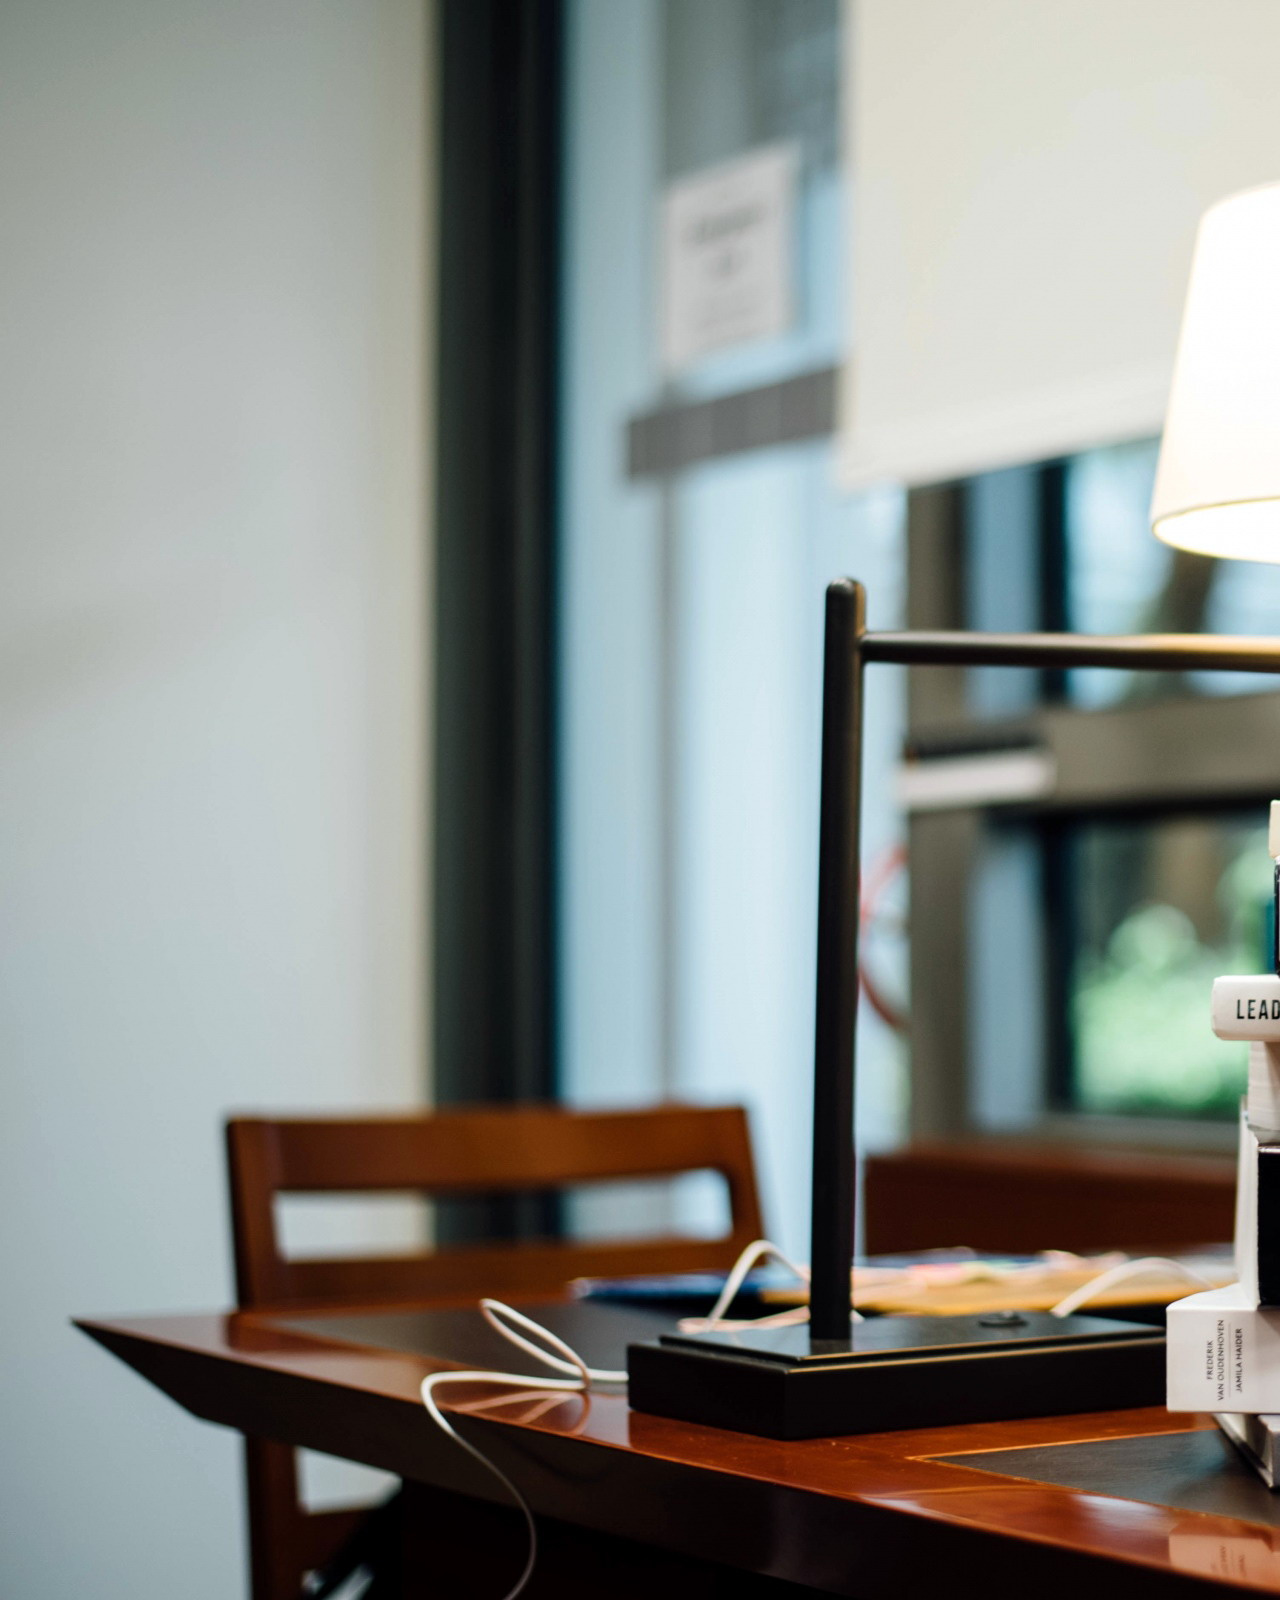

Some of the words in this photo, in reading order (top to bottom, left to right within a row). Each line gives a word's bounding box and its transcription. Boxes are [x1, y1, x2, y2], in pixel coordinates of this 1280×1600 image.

[1206, 1340, 1214, 1380] FREDERIK
[1217, 1319, 1225, 1381] OUDENHOVEN
[1235, 1328, 1243, 1360] HAIDER
[1217, 1383, 1225, 1401] VAN
[1235, 1362, 1243, 1393] JAMILA
